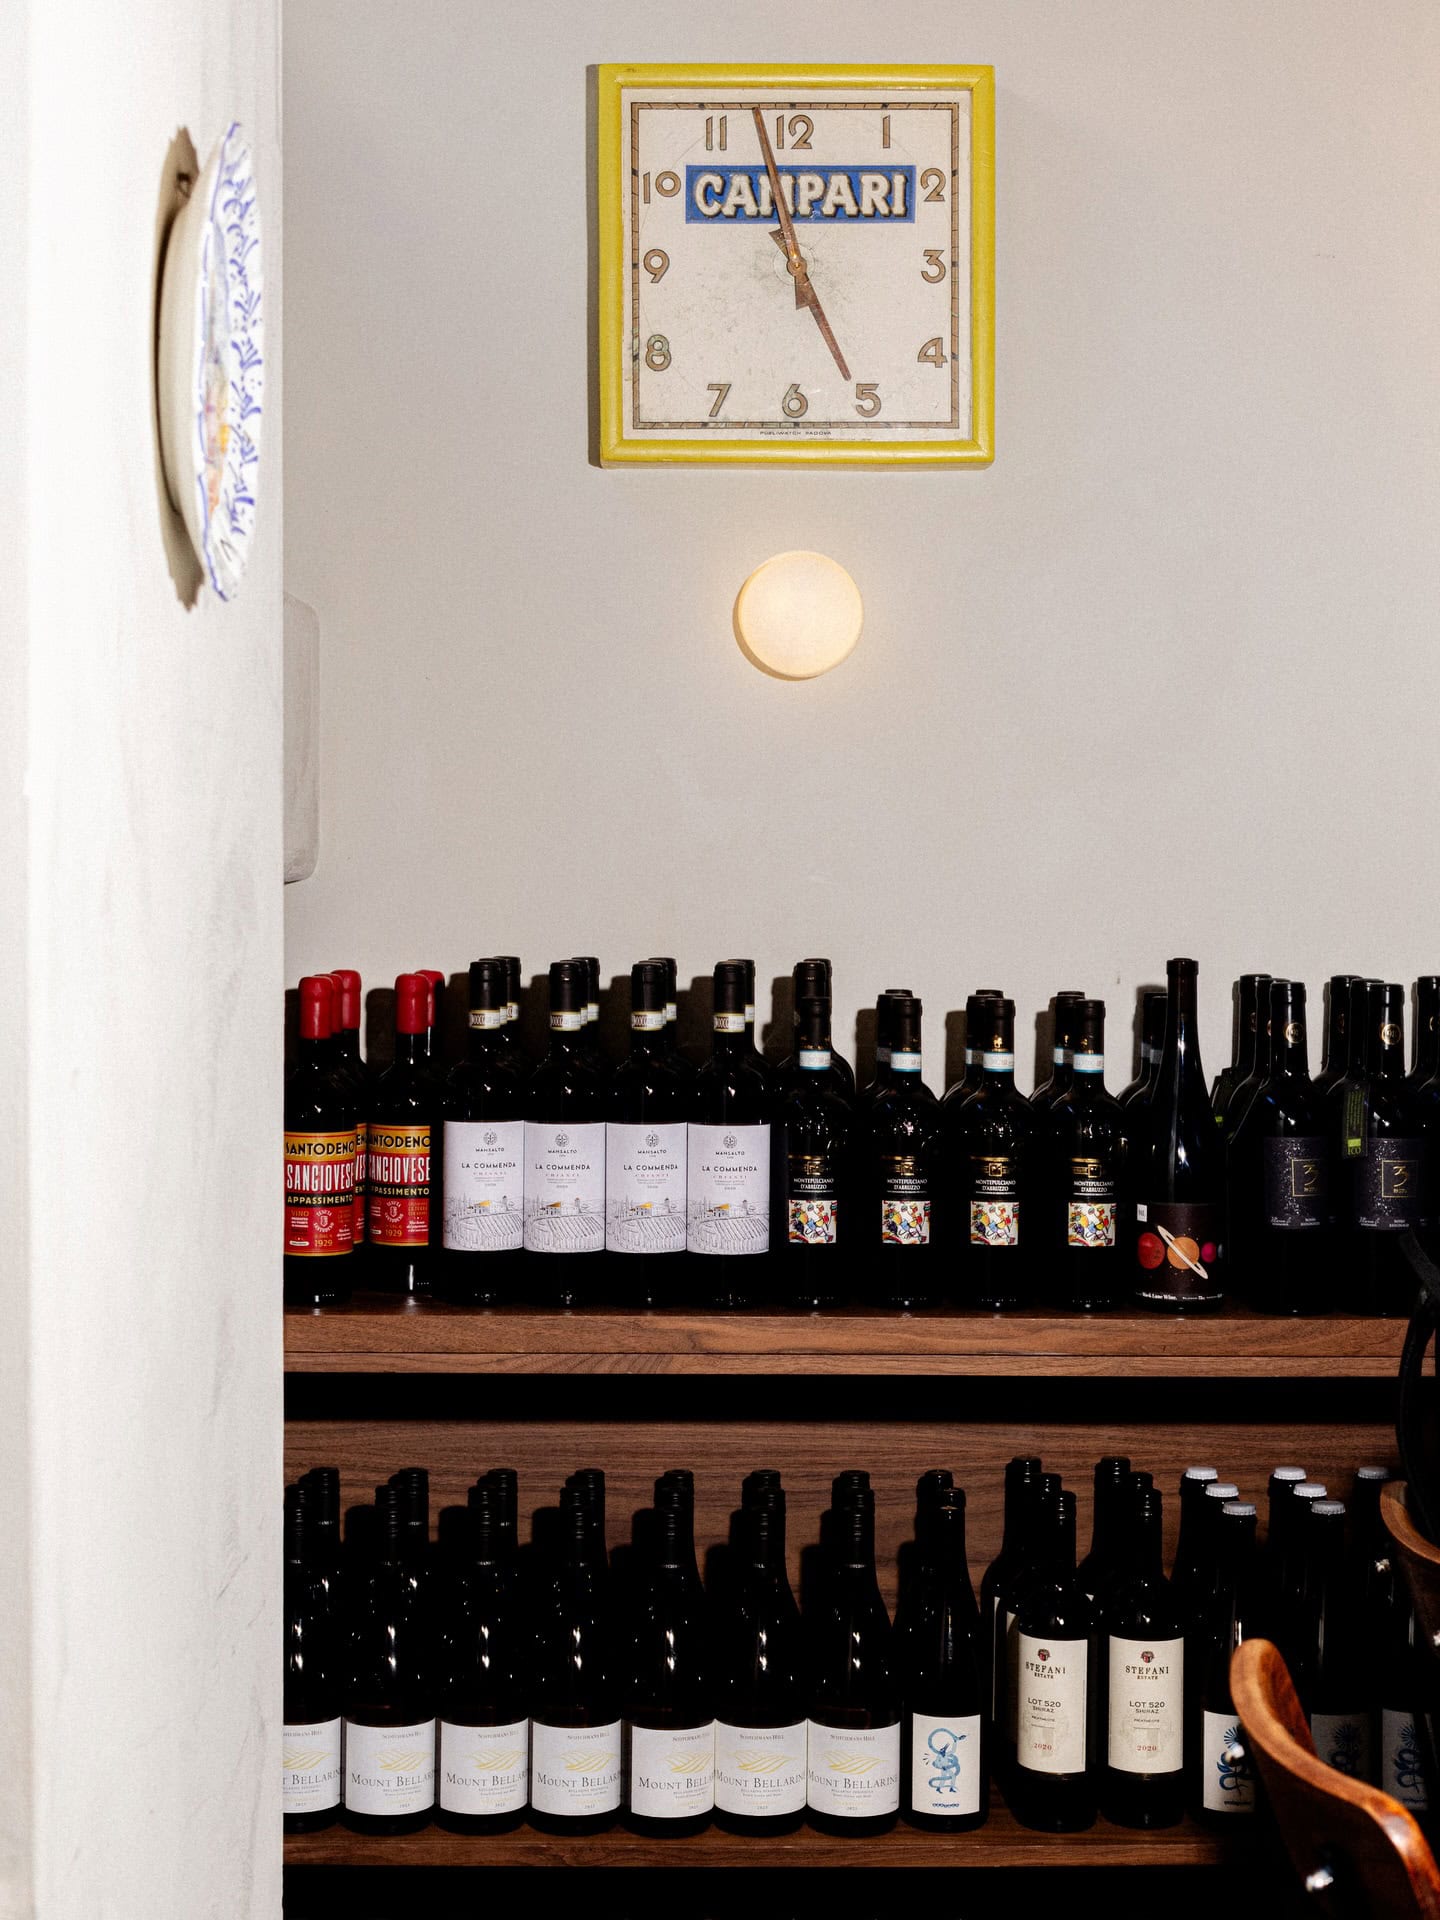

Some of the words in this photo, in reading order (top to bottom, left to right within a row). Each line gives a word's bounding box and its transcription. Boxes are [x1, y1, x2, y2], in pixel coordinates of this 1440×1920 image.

[705, 115, 728, 151] 11
[776, 114, 814, 150] 12
[881, 114, 892, 150] 1
[642, 170, 682, 204] 10
[920, 167, 946, 202] 2
[694, 172, 907, 218] CAMPARI
[643, 248, 670, 284] 9
[920, 249, 947, 284] 3
[645, 334, 672, 372] 8
[917, 337, 948, 369] 4
[706, 383, 732, 418] 7
[781, 383, 809, 418] 6
[855, 383, 882, 418] 5
[369, 1135, 431, 1148] ANTODENO
[474, 1161, 517, 1169] COMMENDA
[636, 1163, 678, 1171] COMMENDA
[287, 1162, 354, 1192] SANGIOVESE
[371, 1186, 430, 1196] PASSIMENTO
[287, 1195, 353, 1206] APPASSIMENTO
[1025, 1661, 1066, 1675] STEFANI
[1125, 1665, 1169, 1675] STEFANI
[1028, 1697, 1041, 1705] LOT
[1044, 1700, 1061, 1708] 520
[1032, 1705, 1054, 1713] SHIRAZ
[1129, 1700, 1146, 1708] LOT
[1034, 1743, 1052, 1751] 2020
[292, 1767, 342, 1785] BELLARIN
[352, 1772, 391, 1788] MOUNT
[446, 1772, 487, 1787] MOUNT
[492, 1770, 527, 1787] BELLAR
[537, 1772, 577, 1788] MOUNT
[582, 1770, 621, 1788] BELLAR
[639, 1776, 681, 1790] MOUNT
[717, 1769, 749, 1787] MOUNT
[754, 1774, 805, 1788] BELLARIN
[808, 1769, 840, 1788] MOUNT
